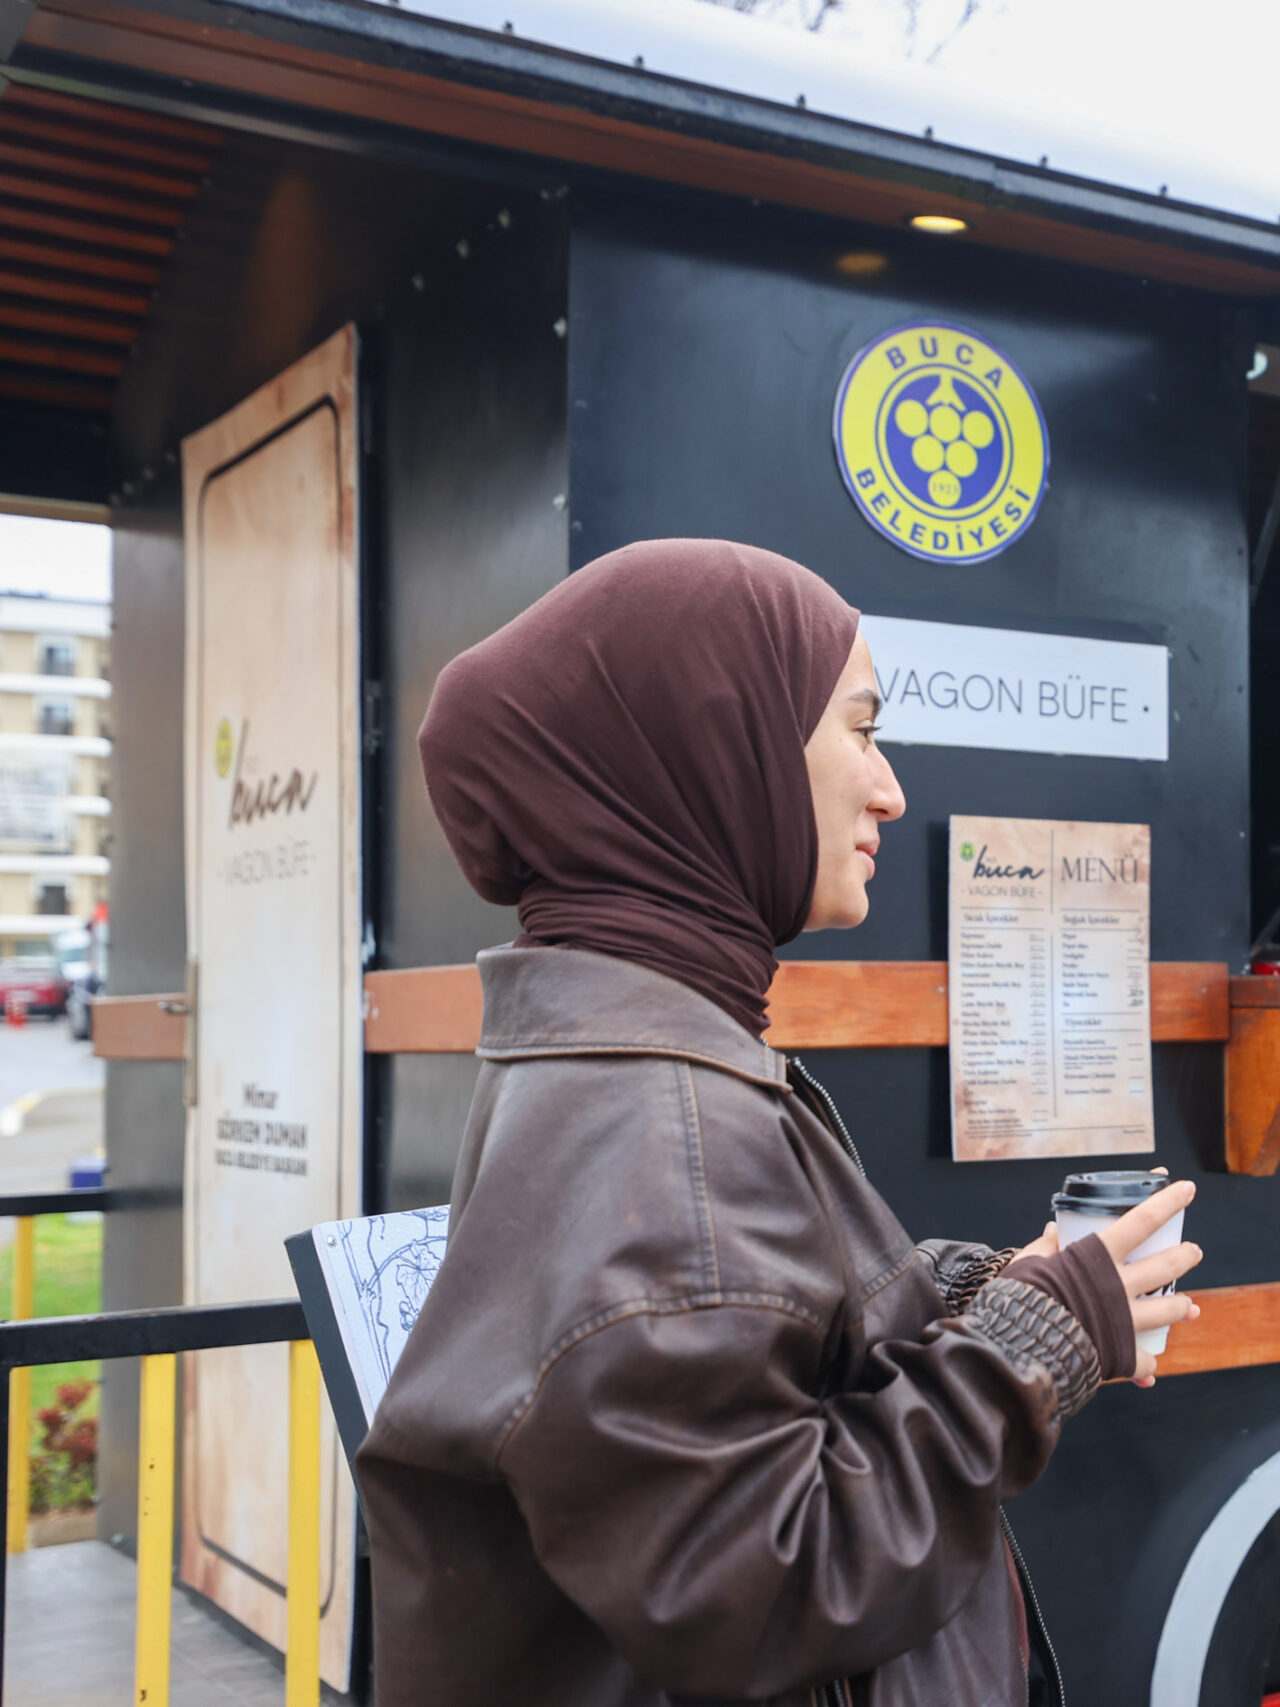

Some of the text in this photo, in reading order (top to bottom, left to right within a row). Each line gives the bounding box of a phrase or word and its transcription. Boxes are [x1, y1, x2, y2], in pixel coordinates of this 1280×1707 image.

[884, 336, 1003, 389] BUCA
[856, 467, 1031, 551] BELEDİYESİ
[874, 665, 1128, 723] VAGON BÜFE
[967, 883, 1037, 898] VAGON BÜFE
[1061, 853, 1138, 883] MENÜ
